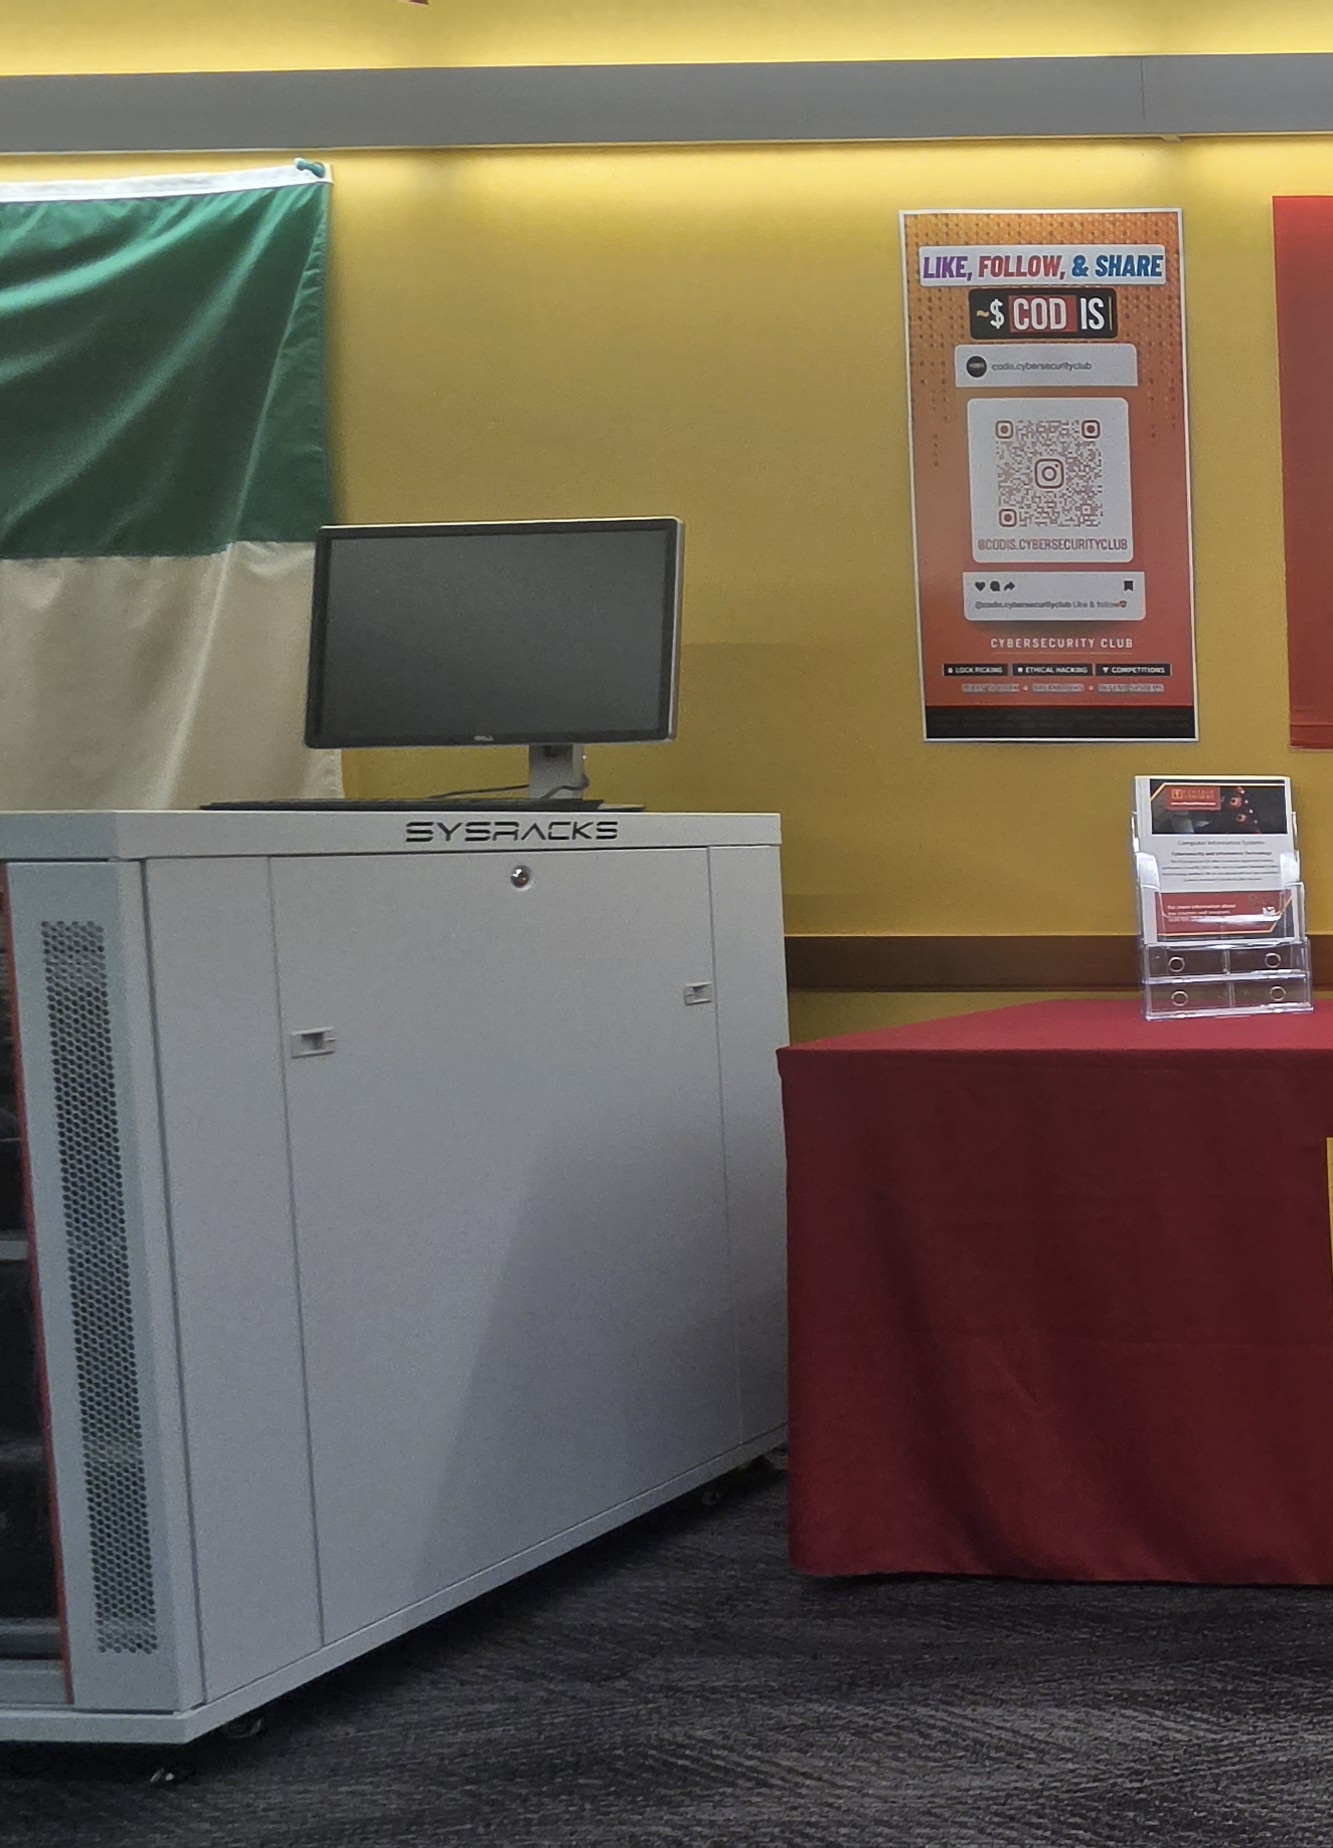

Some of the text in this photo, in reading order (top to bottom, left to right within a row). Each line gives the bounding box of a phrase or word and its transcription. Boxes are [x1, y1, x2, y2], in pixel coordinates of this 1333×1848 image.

[923, 255, 1164, 282] LIKE, FOLLOW, & SHARE
[1013, 298, 1067, 331] COD
[1080, 297, 1106, 331] IS
[978, 538, 1129, 551] @CODIS.CYBERSECURITYCLUB
[990, 637, 1133, 649] CYBERSECURITY CLUB
[404, 821, 618, 843] SYSRACKS
